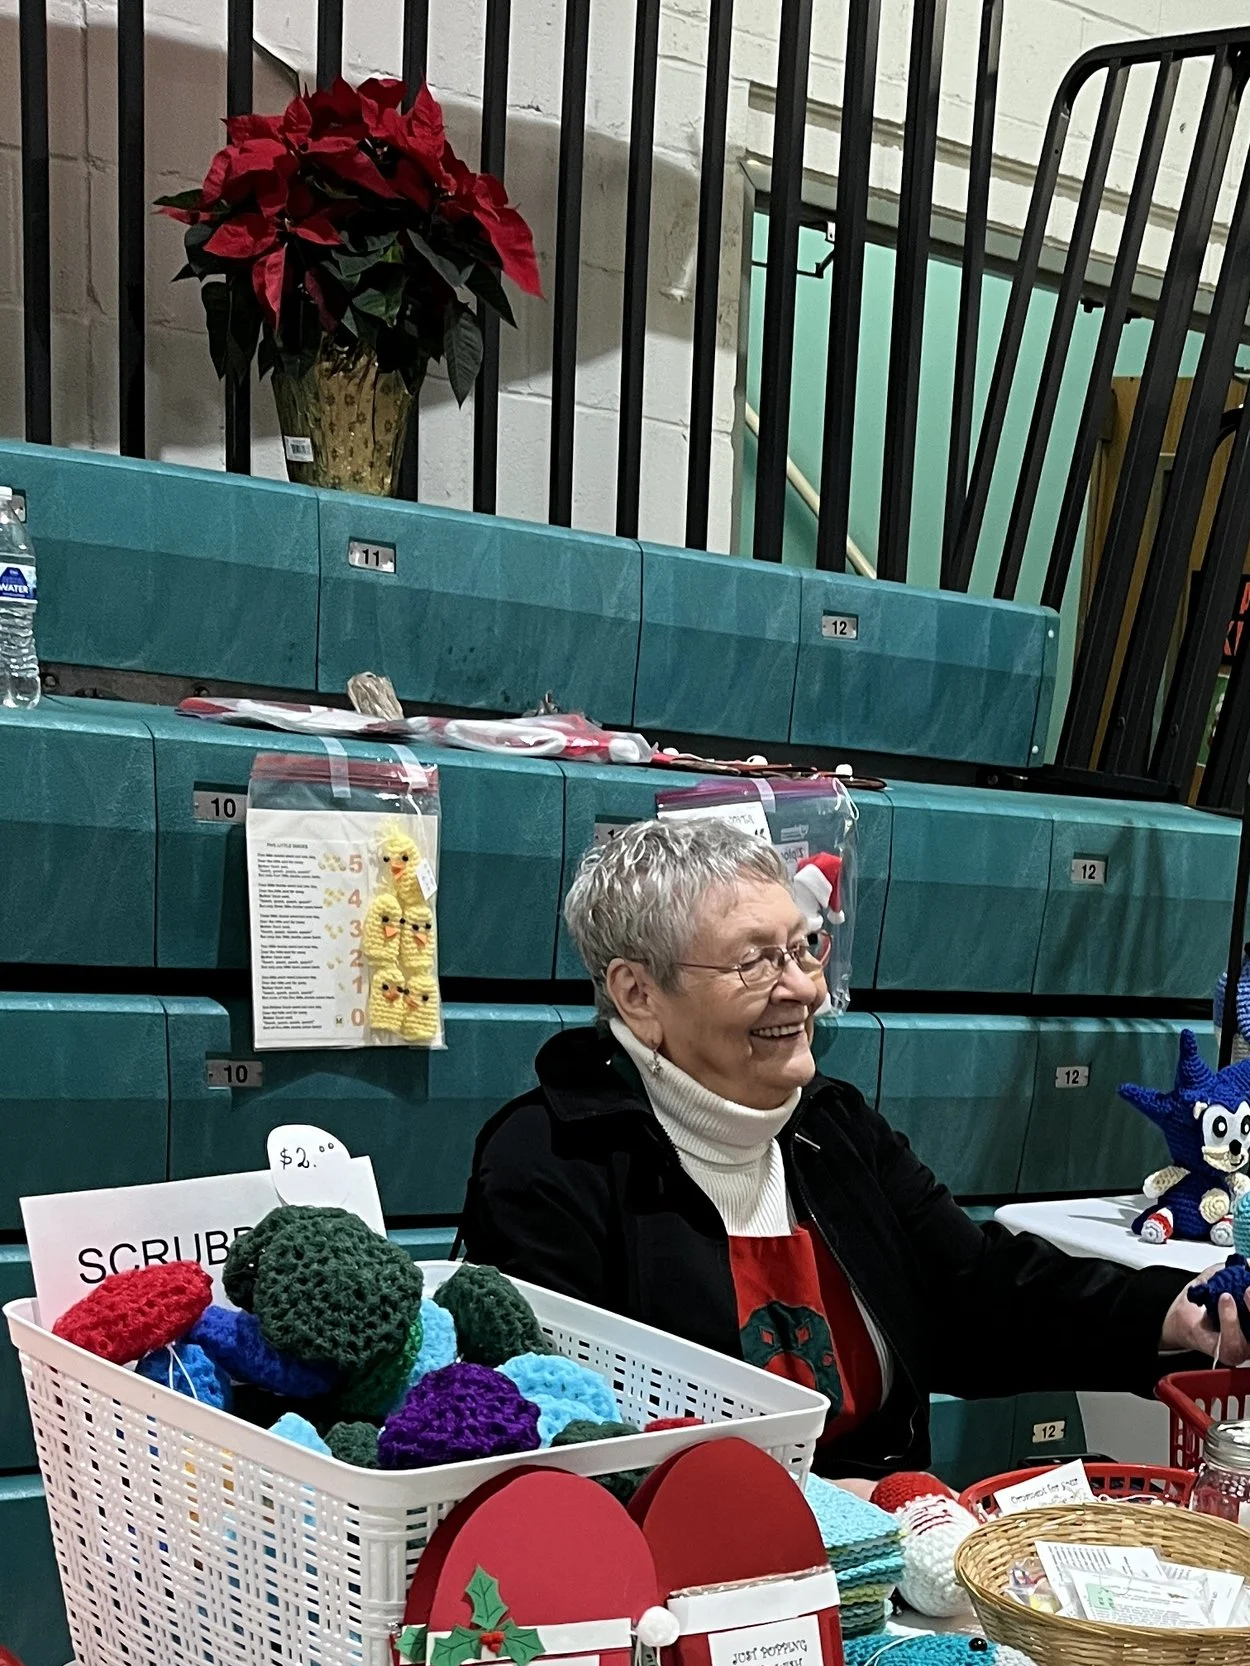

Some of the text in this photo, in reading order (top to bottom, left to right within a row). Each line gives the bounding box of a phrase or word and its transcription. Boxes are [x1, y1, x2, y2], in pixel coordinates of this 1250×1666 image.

[362, 548, 380, 567] 11
[832, 620, 847, 635] 12
[211, 797, 236, 818] 10
[349, 854, 363, 873] 5
[1082, 864, 1096, 879] 12
[348, 888, 362, 908] 4
[350, 920, 363, 938] 3
[350, 951, 363, 967] 2
[352, 976, 362, 994] 1
[351, 1008, 365, 1026] 0
[223, 1065, 248, 1083] 10
[1065, 1070, 1079, 1084] 12
[78, 1226, 254, 1285] SCRUB
[1042, 1425, 1056, 1439] 12
[732, 1639, 807, 1665] JUST POPPING
